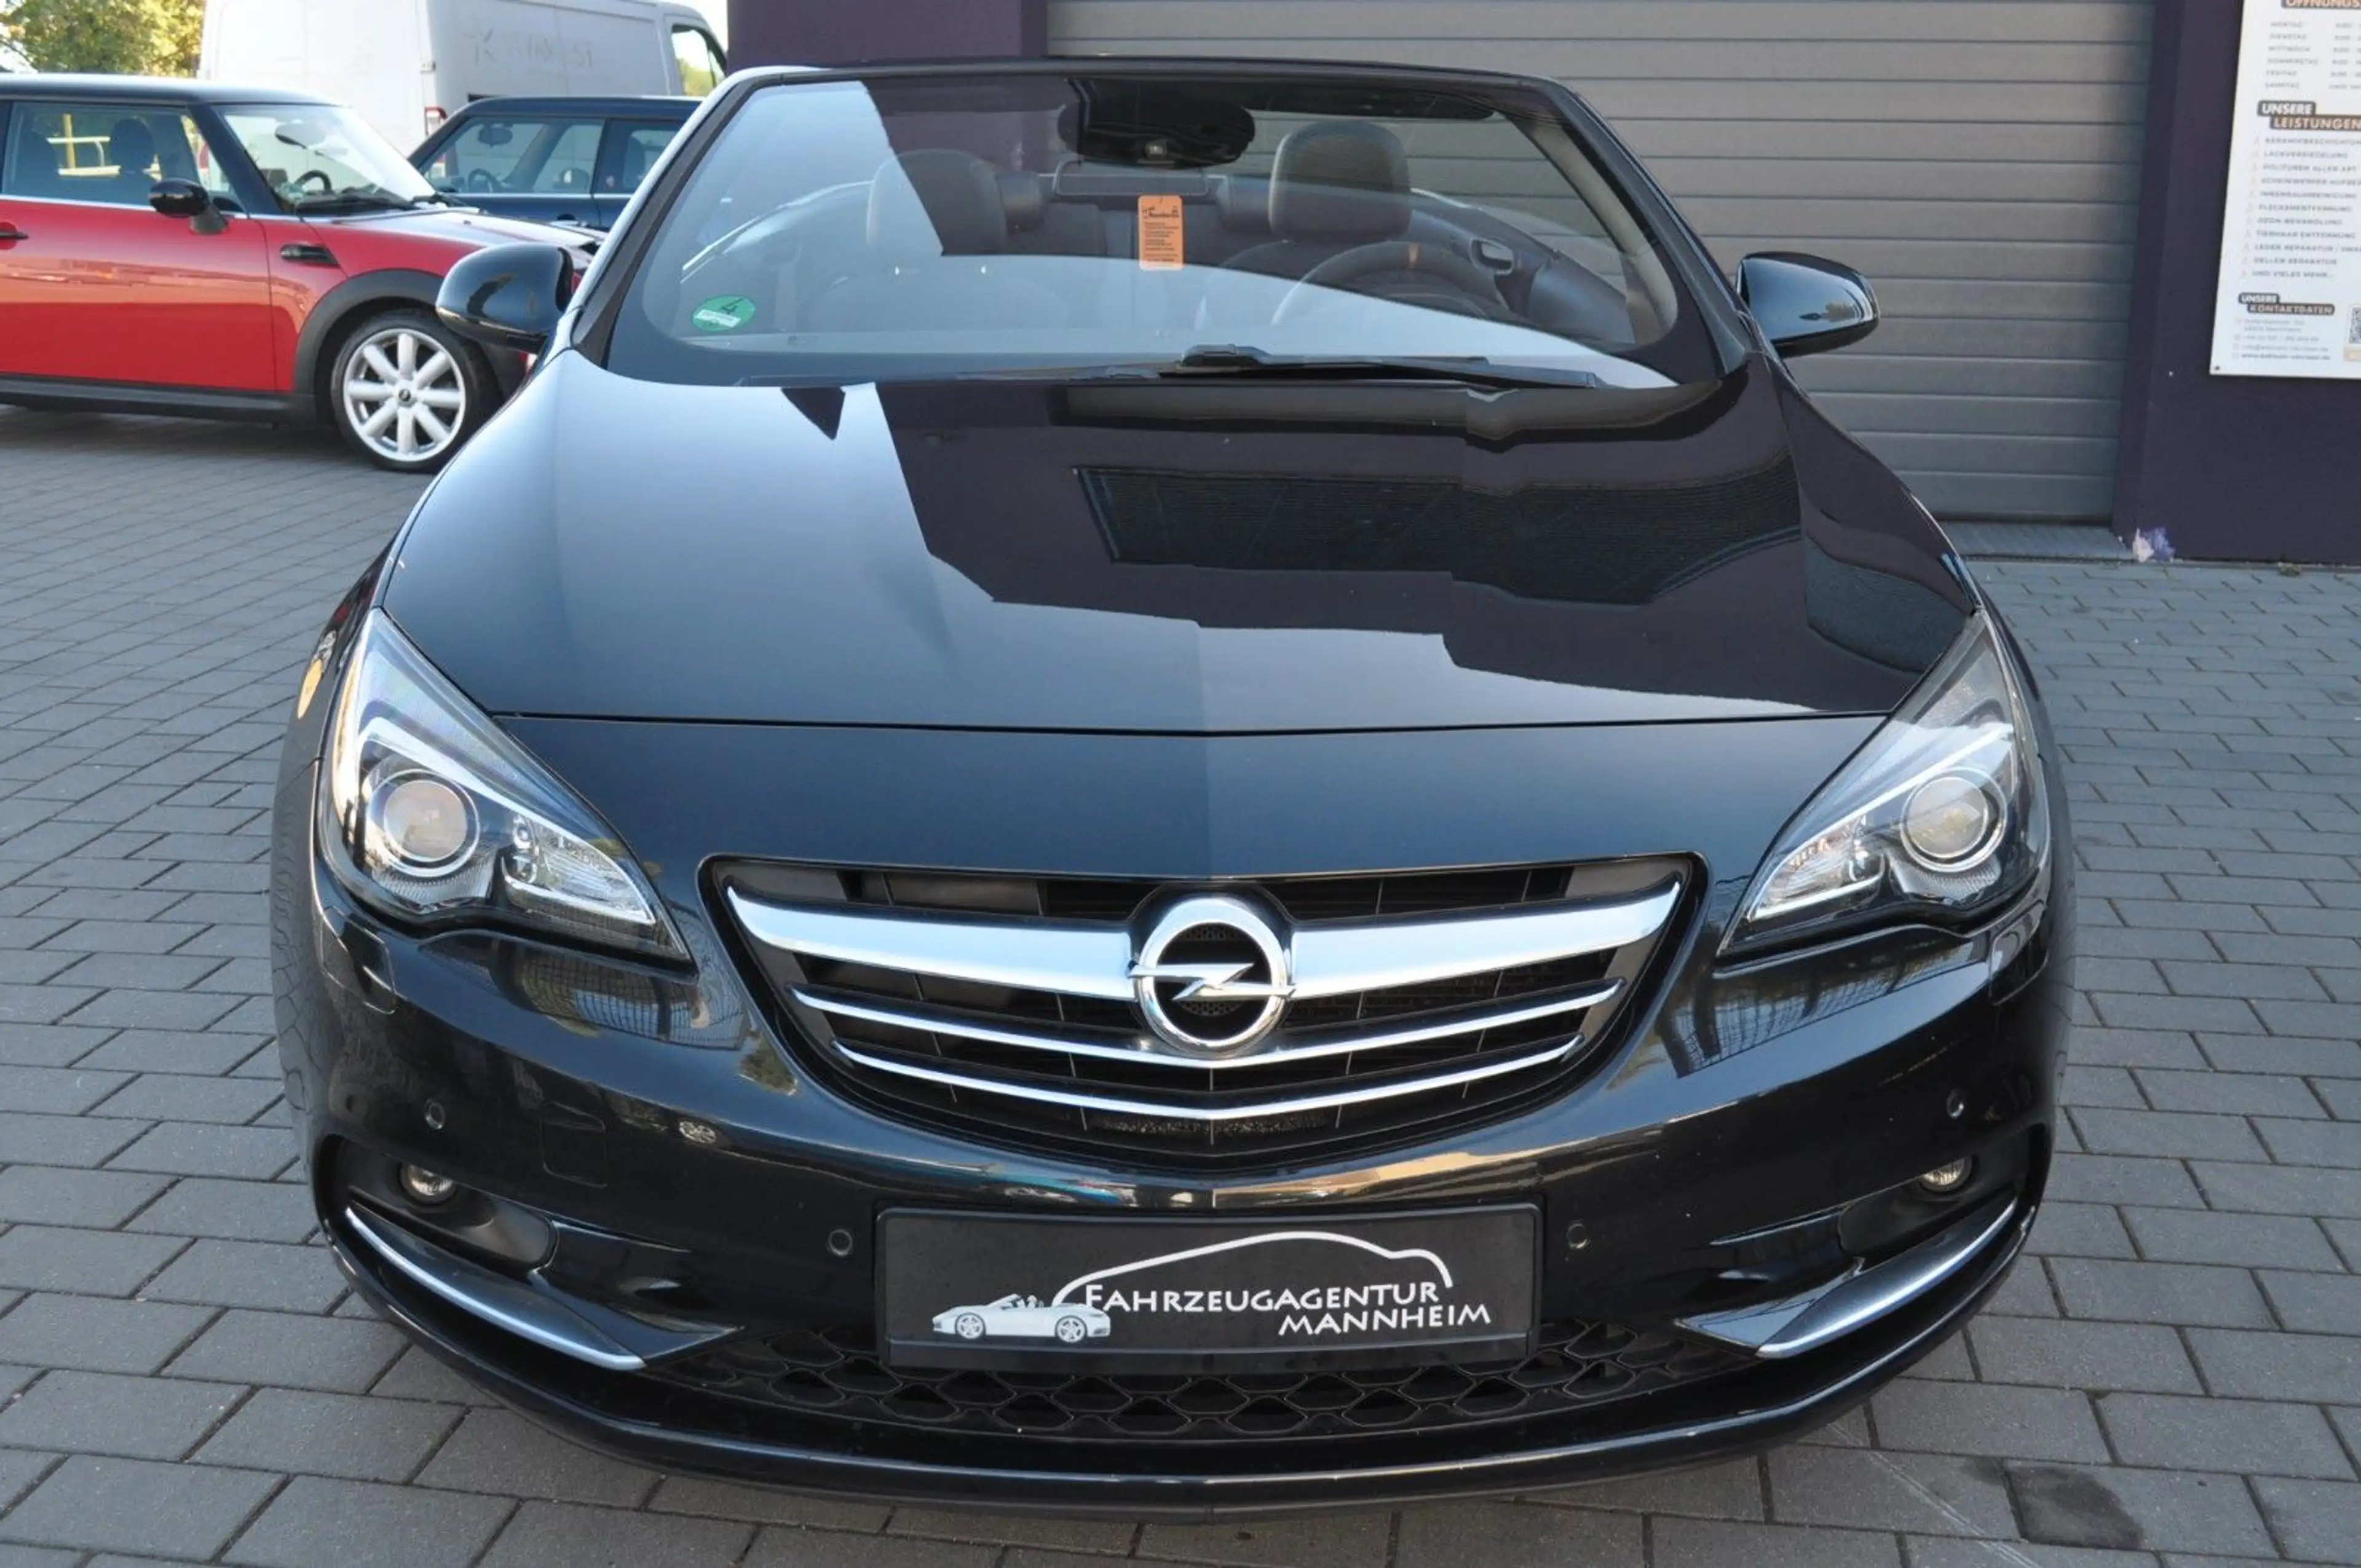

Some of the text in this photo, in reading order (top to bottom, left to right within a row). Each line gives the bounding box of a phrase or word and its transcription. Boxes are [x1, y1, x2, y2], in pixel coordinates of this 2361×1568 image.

[2261, 103, 2313, 115] UNSERE
[2274, 117, 2361, 130] LEISTUNGEN
[1085, 1281, 1439, 1312] FAHRZEUGAGENTUR
[1278, 1303, 1491, 1336] MANNHEIM
